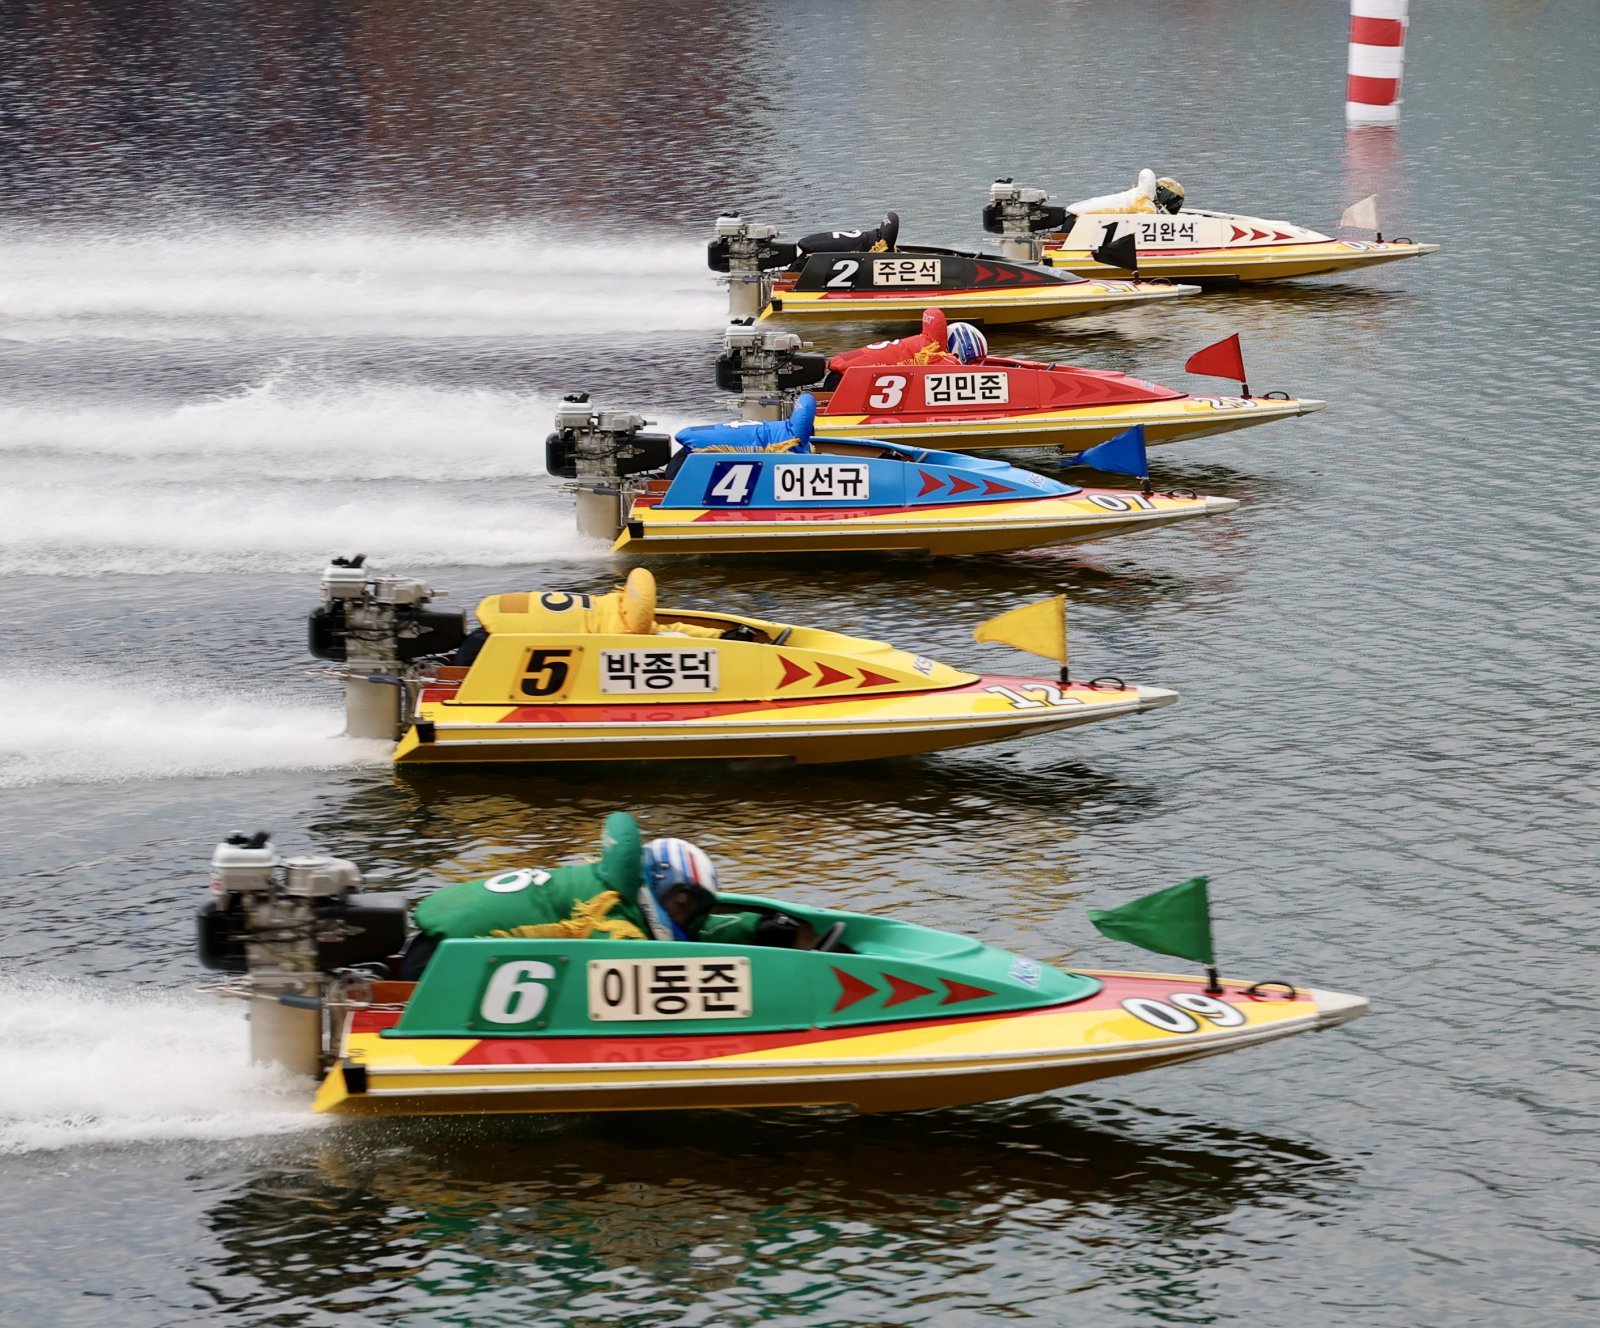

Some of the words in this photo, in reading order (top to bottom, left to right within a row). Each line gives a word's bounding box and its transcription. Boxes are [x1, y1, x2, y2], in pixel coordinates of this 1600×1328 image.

[1098, 222, 1120, 252] 1
[1141, 222, 1194, 242] 김완석
[826, 260, 860, 288] 2
[878, 261, 936, 282] 주은석
[869, 375, 907, 409] 3
[930, 374, 1003, 402] 김민준
[711, 464, 754, 503] 4
[781, 466, 863, 497] 어선규
[1086, 493, 1156, 511] 07
[520, 649, 573, 696] 5
[607, 651, 711, 690] 박종덕
[983, 683, 1084, 710] 12
[480, 960, 556, 1024] 6
[602, 963, 742, 1016] 이동준
[1120, 992, 1247, 1034] 09
